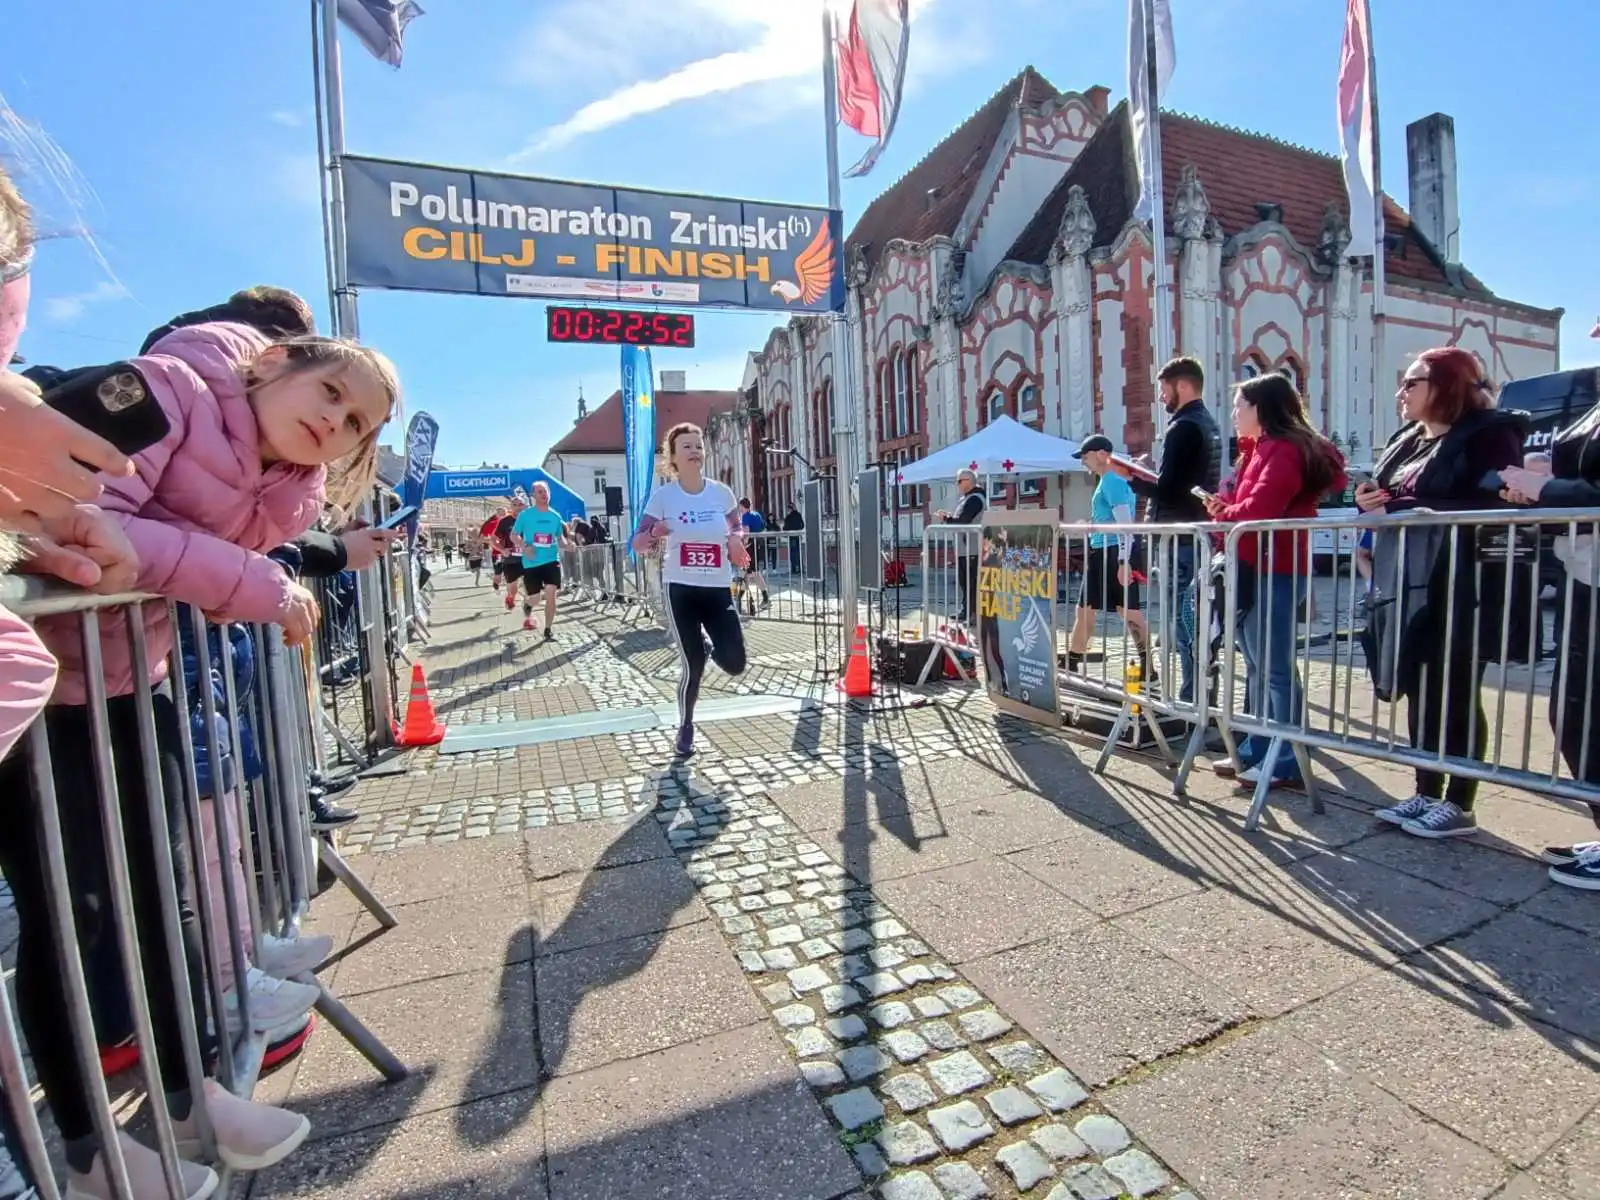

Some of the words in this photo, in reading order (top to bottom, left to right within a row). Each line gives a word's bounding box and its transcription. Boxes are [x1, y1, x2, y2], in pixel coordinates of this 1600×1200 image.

[390, 181, 652, 242] Polumaraton
[403, 226, 536, 268] CILJ
[595, 243, 770, 282] FINISH
[551, 308, 692, 345] 00:22:52
[448, 476, 506, 488] DECATHLON
[687, 552, 716, 566] 332
[980, 567, 1053, 599] ZRINSKI
[980, 590, 1022, 621] HALF
